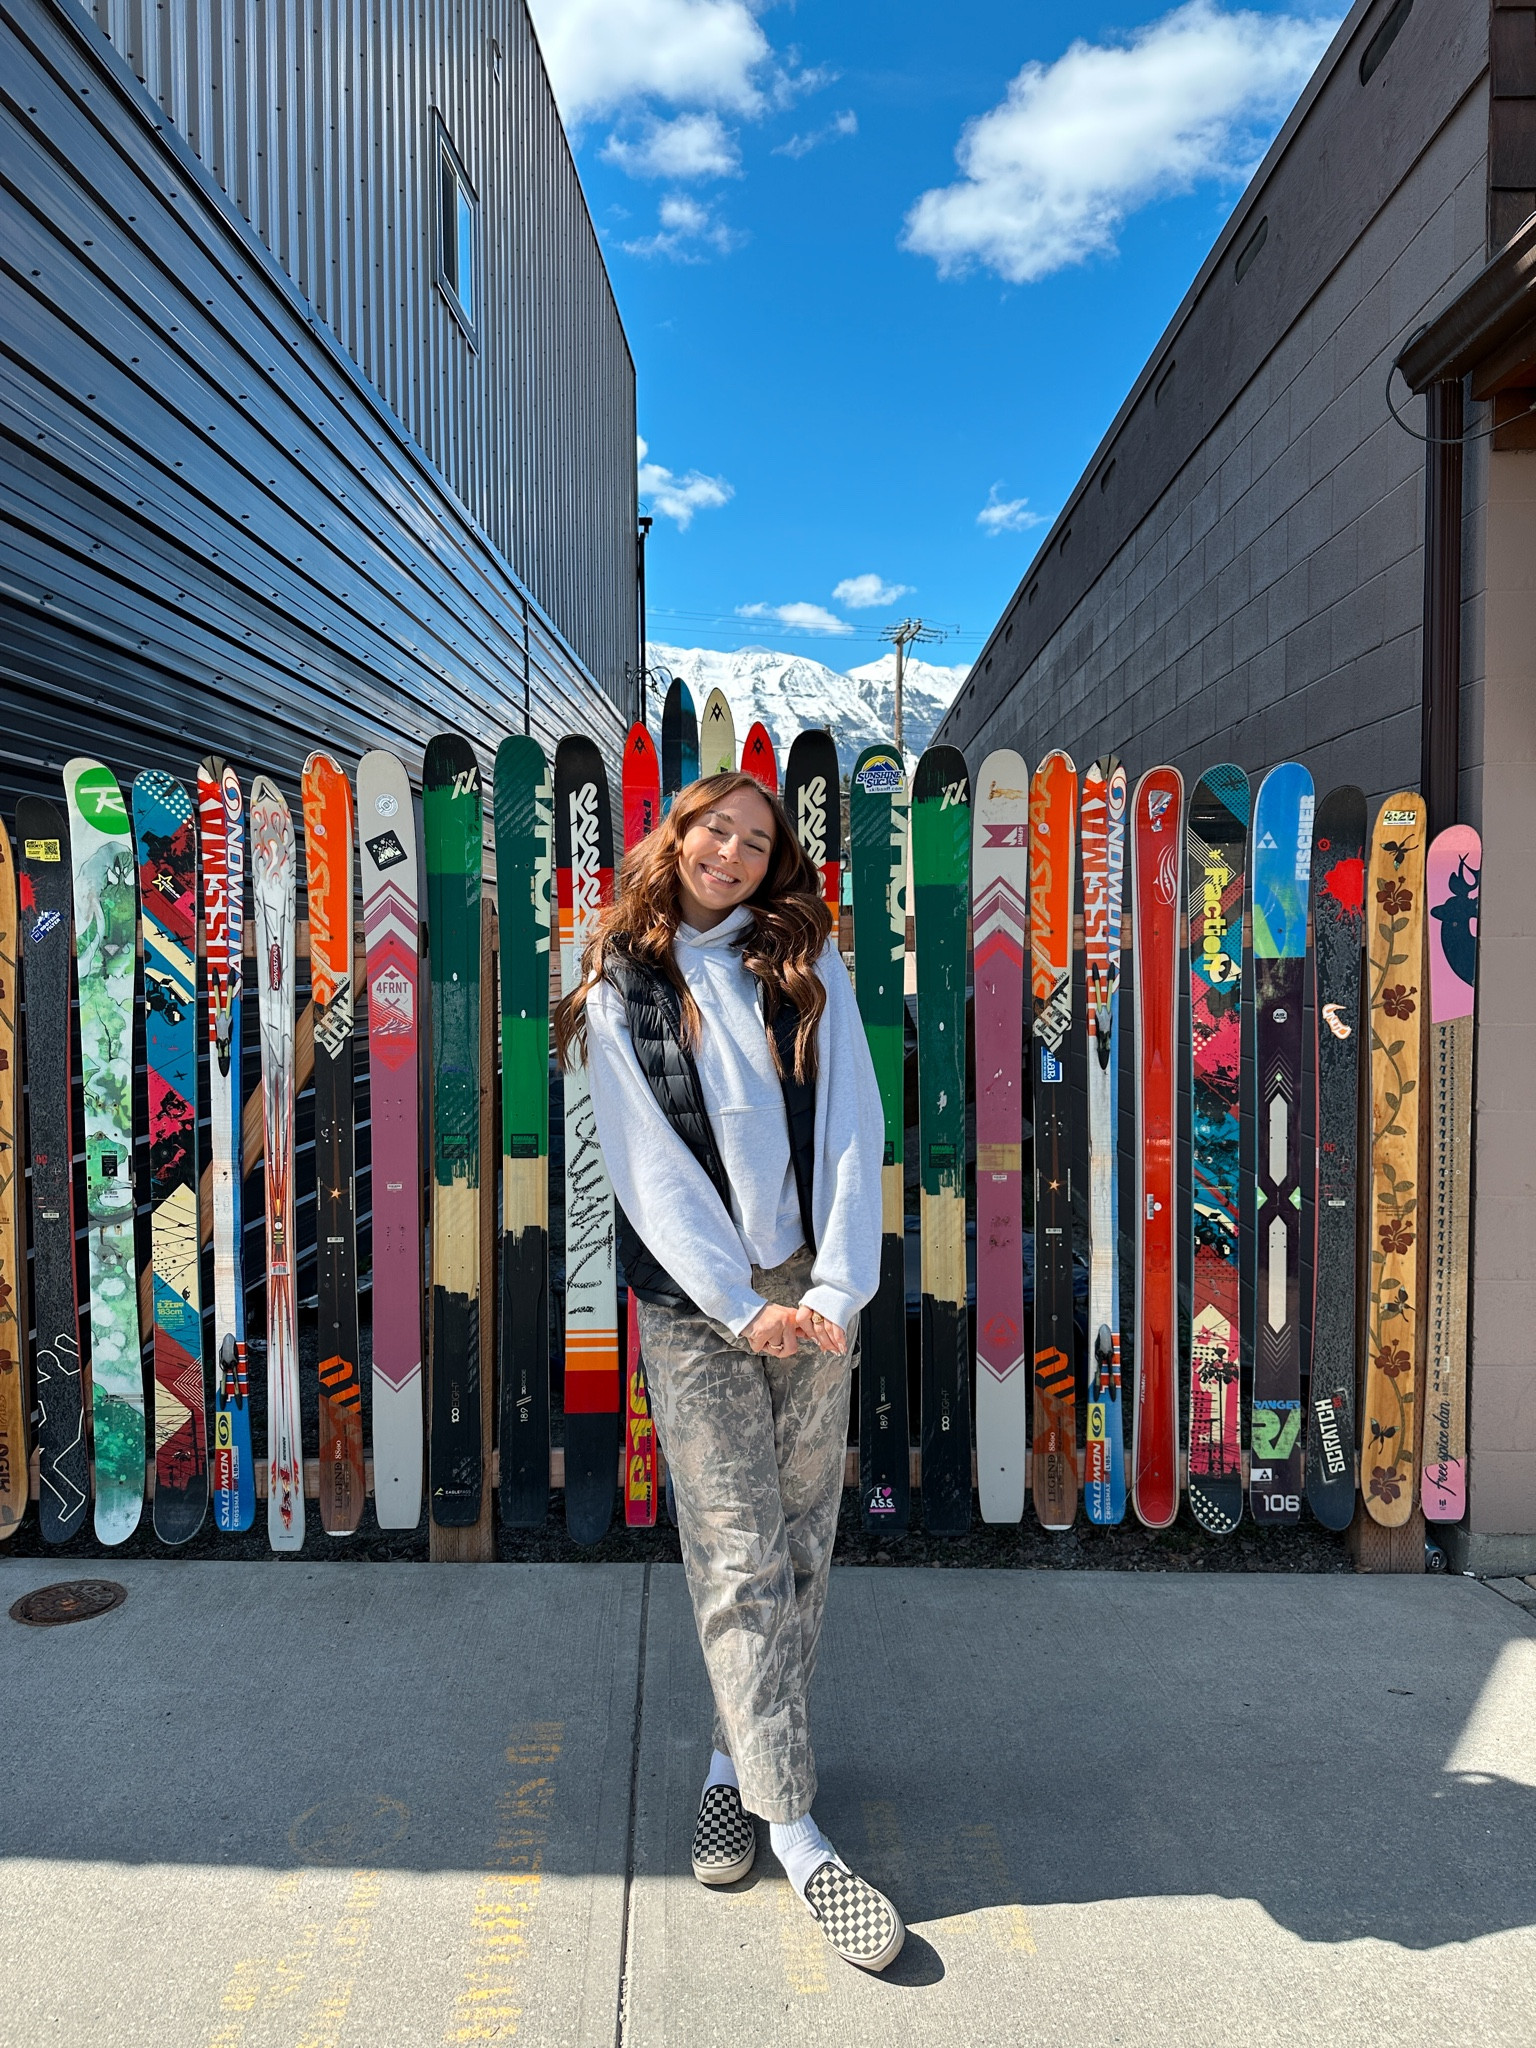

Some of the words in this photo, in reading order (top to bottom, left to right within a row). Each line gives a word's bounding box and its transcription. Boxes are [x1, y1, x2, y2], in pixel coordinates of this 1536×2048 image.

[857, 771, 902, 782] SUNSHINE
[866, 778, 898, 788] SUCKS
[1295, 795, 1315, 881] FISCHER
[302, 766, 333, 1005] DYNASTAR
[1029, 762, 1054, 1000] DYNASTAR
[45, 918, 61, 932] FILTER
[376, 982, 409, 994] 4FRNT
[1254, 1400, 1300, 1410] RANGER
[520, 1407, 528, 1423] 189
[880, 1414, 888, 1430] 189
[1432, 1401, 1451, 1430] elan
[1315, 1398, 1345, 1473] SCRATCH
[334, 1462, 342, 1508] LEGEND
[1093, 1443, 1102, 1521] SALOMON
[1425, 1463, 1456, 1496] free
[220, 1451, 230, 1528] SALOMON
[874, 1487, 882, 1498] I
[870, 1498, 895, 1508] A.S.S.
[1263, 1494, 1300, 1512] 106
